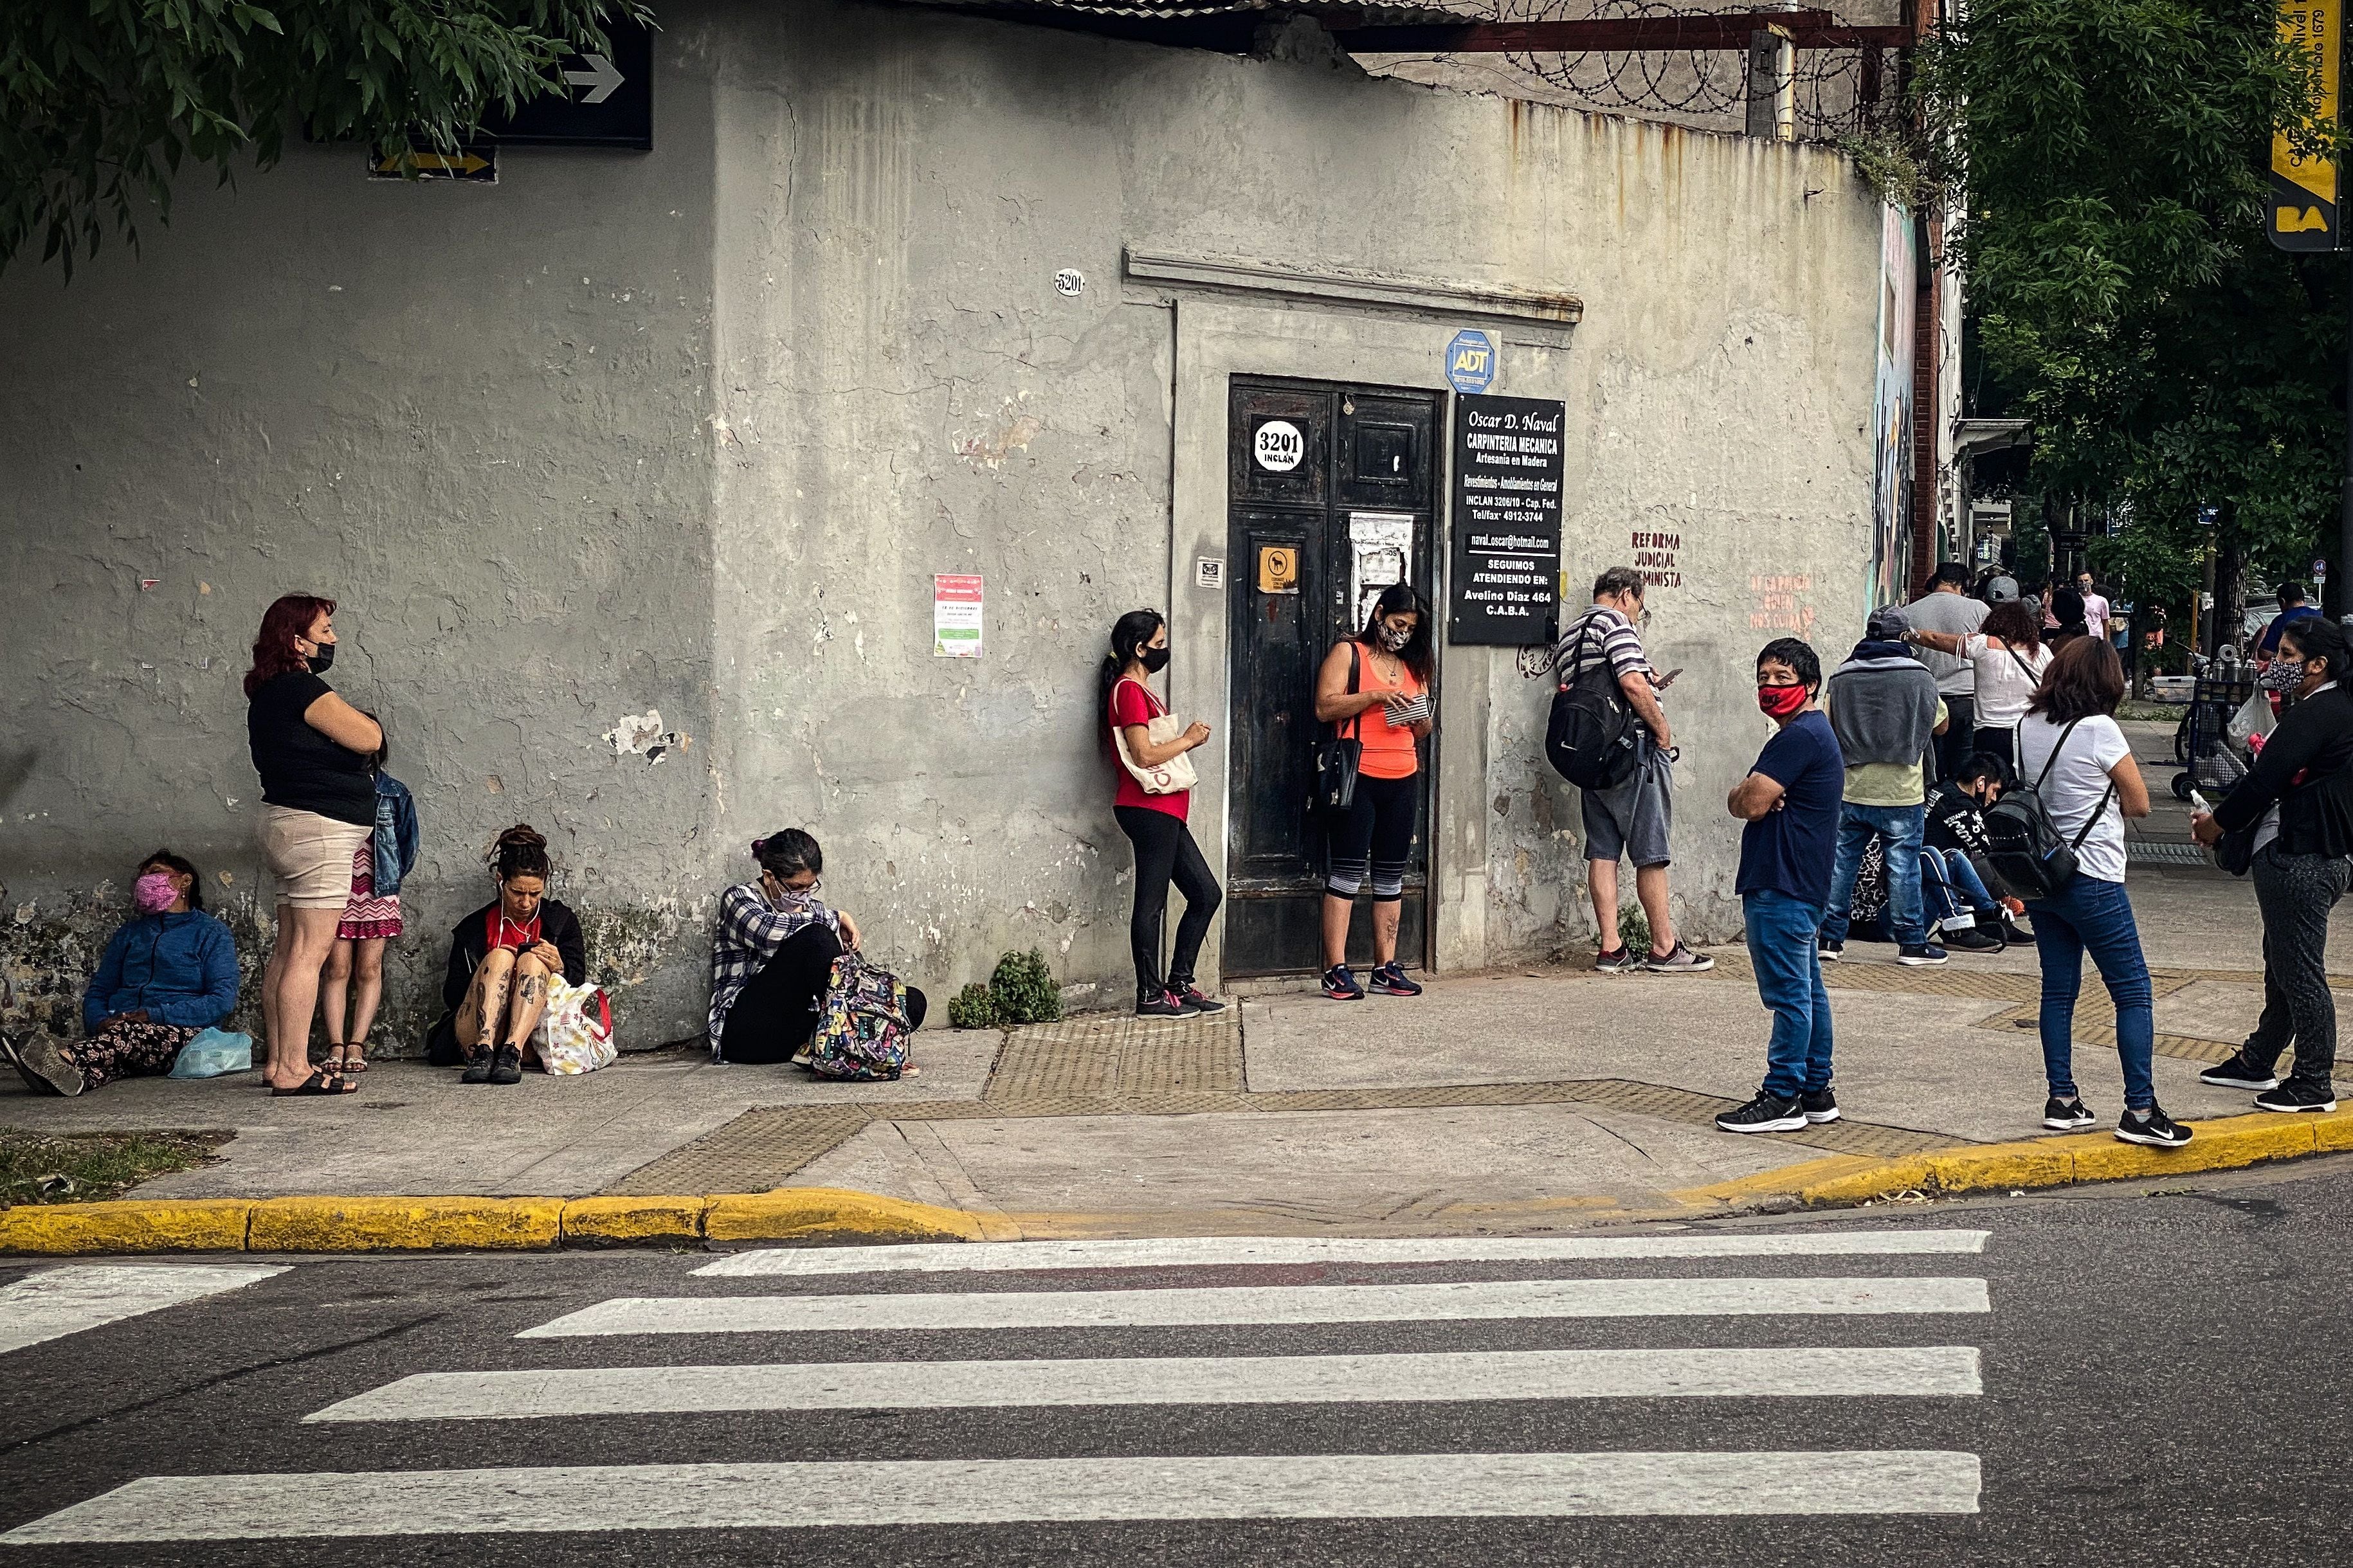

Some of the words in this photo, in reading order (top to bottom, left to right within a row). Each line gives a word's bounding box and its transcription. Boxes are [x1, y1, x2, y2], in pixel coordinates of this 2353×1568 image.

[2312, 10, 2325, 38] 1679
[1058, 274, 1081, 291] 3201
[1454, 349, 1488, 373] ADT
[1469, 411, 1502, 428] Oscar
[1504, 414, 1519, 429] D.
[1522, 412, 1560, 433] Naval
[1260, 431, 1298, 453] 3201
[1467, 433, 1518, 452] CARPINTERIA
[1518, 437, 1558, 455] MECANICA
[1264, 454, 1295, 465] INCLAN
[1475, 452, 1510, 465] Artesania
[1511, 456, 1520, 465] en
[1522, 455, 1547, 467] Madera
[1540, 478, 1558, 492] General
[1466, 496, 1493, 506] INCLAN
[1525, 498, 1541, 510] Cap.
[1542, 498, 1557, 509] Fed.
[1503, 511, 1543, 522] 4912-3744
[1471, 534, 1549, 550] naval_oscar@hotmail.com
[1631, 532, 1680, 551] REFORMA
[1487, 559, 1535, 571] SEGUIMOS
[1634, 551, 1675, 570] JUDICIAL
[1473, 573, 1531, 584] ATENDIENDO
[1533, 575, 1549, 585] EN:
[1641, 571, 1681, 588] MINISTA
[1464, 590, 1504, 601] Avelino
[1507, 591, 1530, 602] Diaz
[1532, 593, 1551, 603] 464
[1486, 605, 1530, 617] C.A.B.A.
